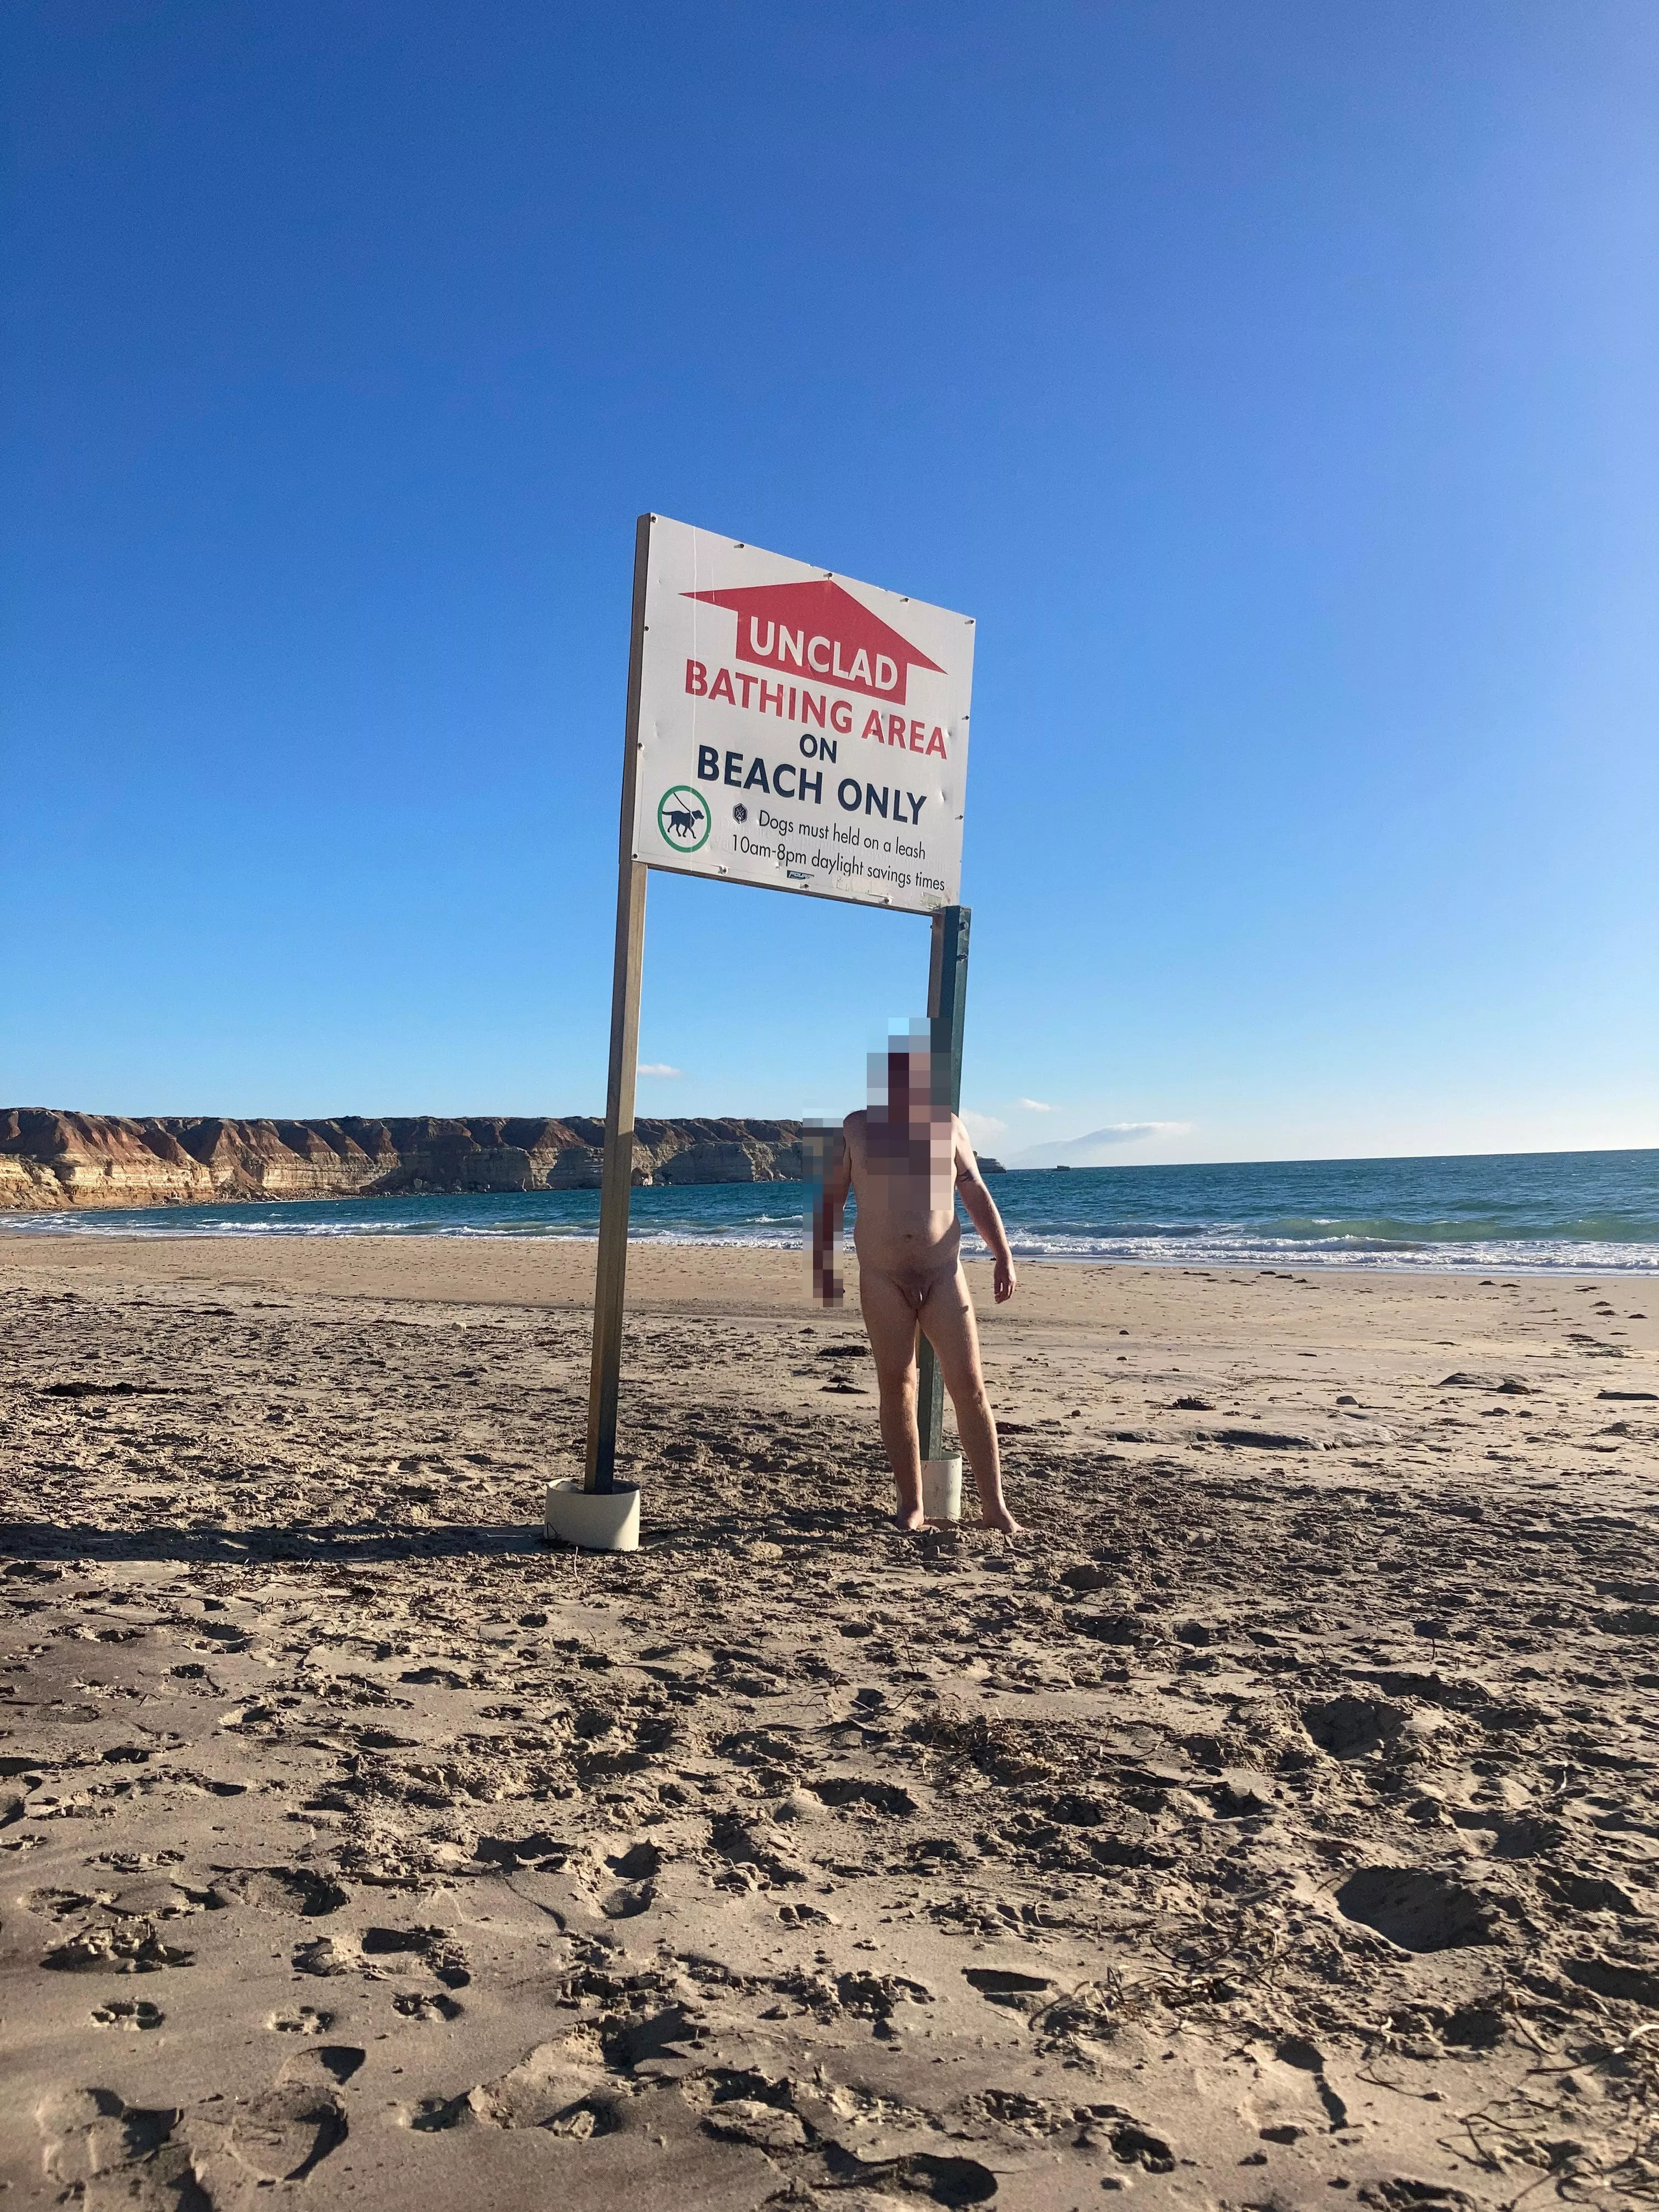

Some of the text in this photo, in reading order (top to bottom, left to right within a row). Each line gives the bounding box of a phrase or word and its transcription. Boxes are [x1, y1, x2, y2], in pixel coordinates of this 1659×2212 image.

[750, 616, 898, 691] UNCLAD
[686, 659, 946, 759] BATHING AREA
[800, 734, 837, 764] ON
[698, 745, 927, 825] BEACH ONLY
[733, 834, 806, 866] 10am-8pm
[811, 849, 864, 876] daylight
[867, 865, 911, 888] savings
[916, 872, 944, 891] times
[759, 810, 793, 836] Dogs
[799, 824, 829, 839] must
[833, 823, 860, 845] held
[864, 838, 878, 850] on
[884, 842, 891, 852] a
[896, 837, 925, 859] leash
